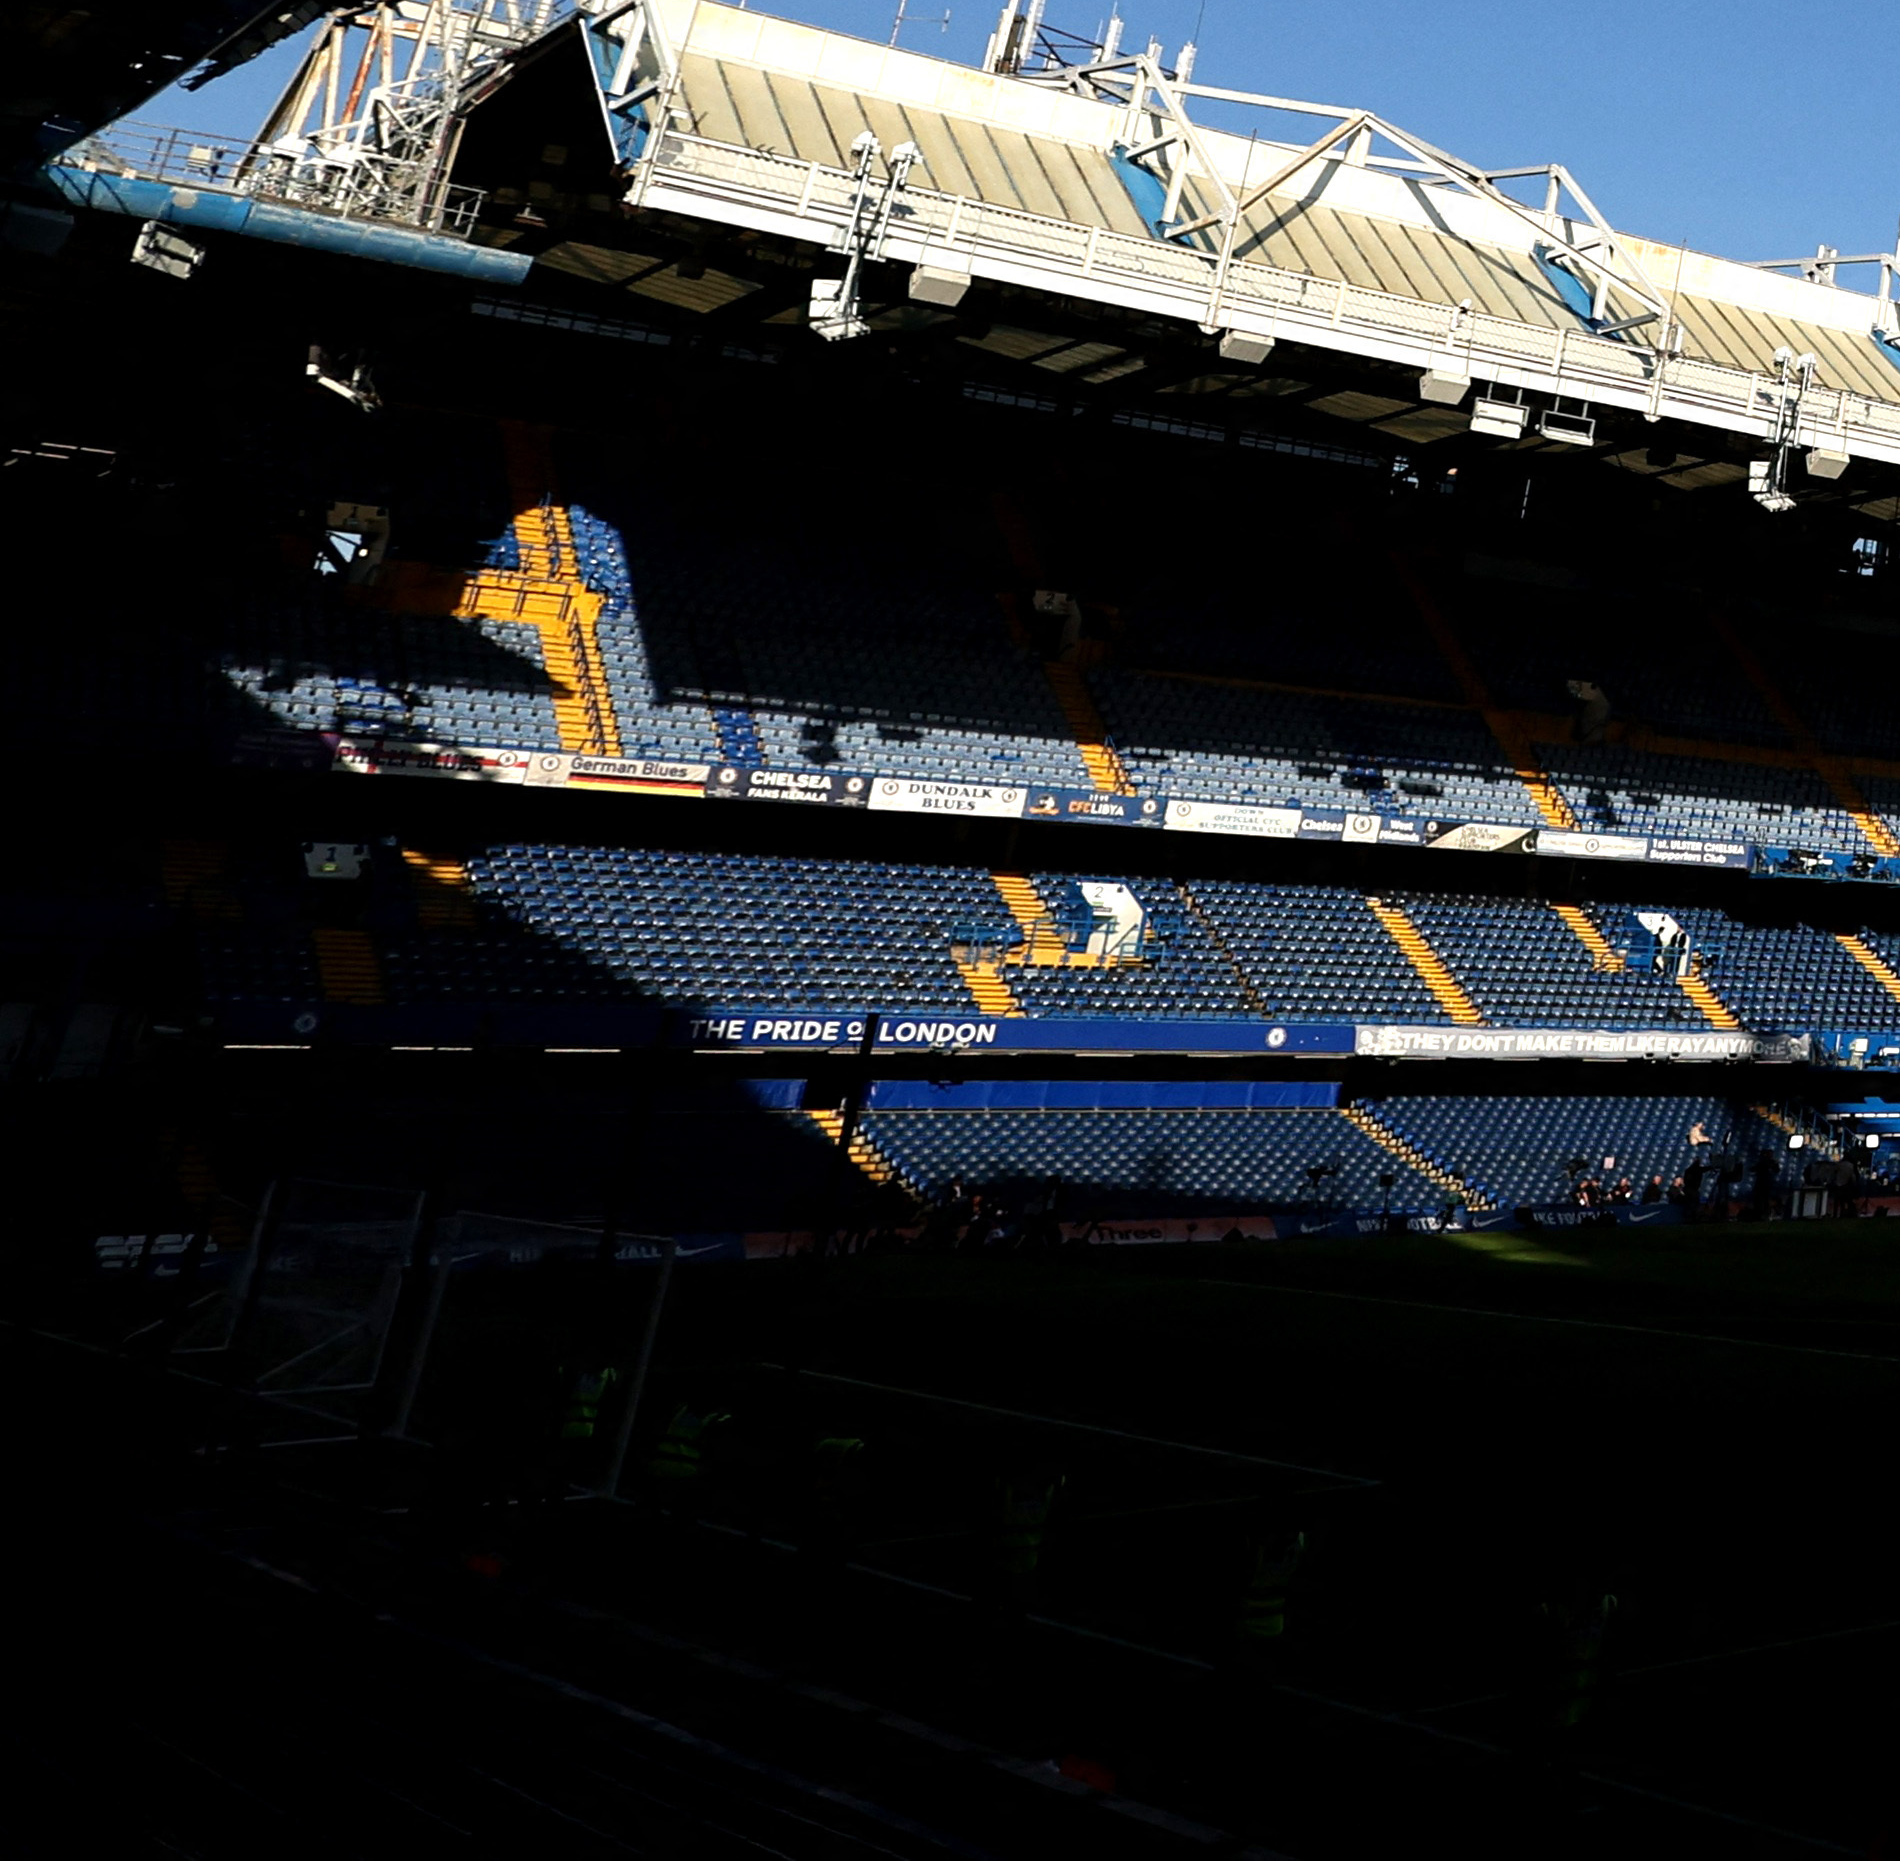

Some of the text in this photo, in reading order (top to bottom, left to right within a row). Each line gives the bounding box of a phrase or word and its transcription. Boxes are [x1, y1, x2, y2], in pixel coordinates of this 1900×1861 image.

[570, 756, 688, 777] German Blues
[750, 770, 832, 790] CHELSEA
[909, 783, 992, 798] DUNDALK
[922, 798, 976, 811] BLUES
[1302, 818, 1344, 832] Chelsea
[325, 847, 336, 862] 1
[1703, 843, 1745, 855] CHELSEA
[1703, 853, 1727, 865] Club
[1094, 886, 1104, 898] 2
[690, 1020, 997, 1043] THE PRIDE O LONDON
[1403, 1033, 1455, 1051] THEY
[1516, 1036, 1574, 1052] MAKE
[1574, 1036, 1625, 1052] THEM
[1625, 1036, 1666, 1052] LIKE
